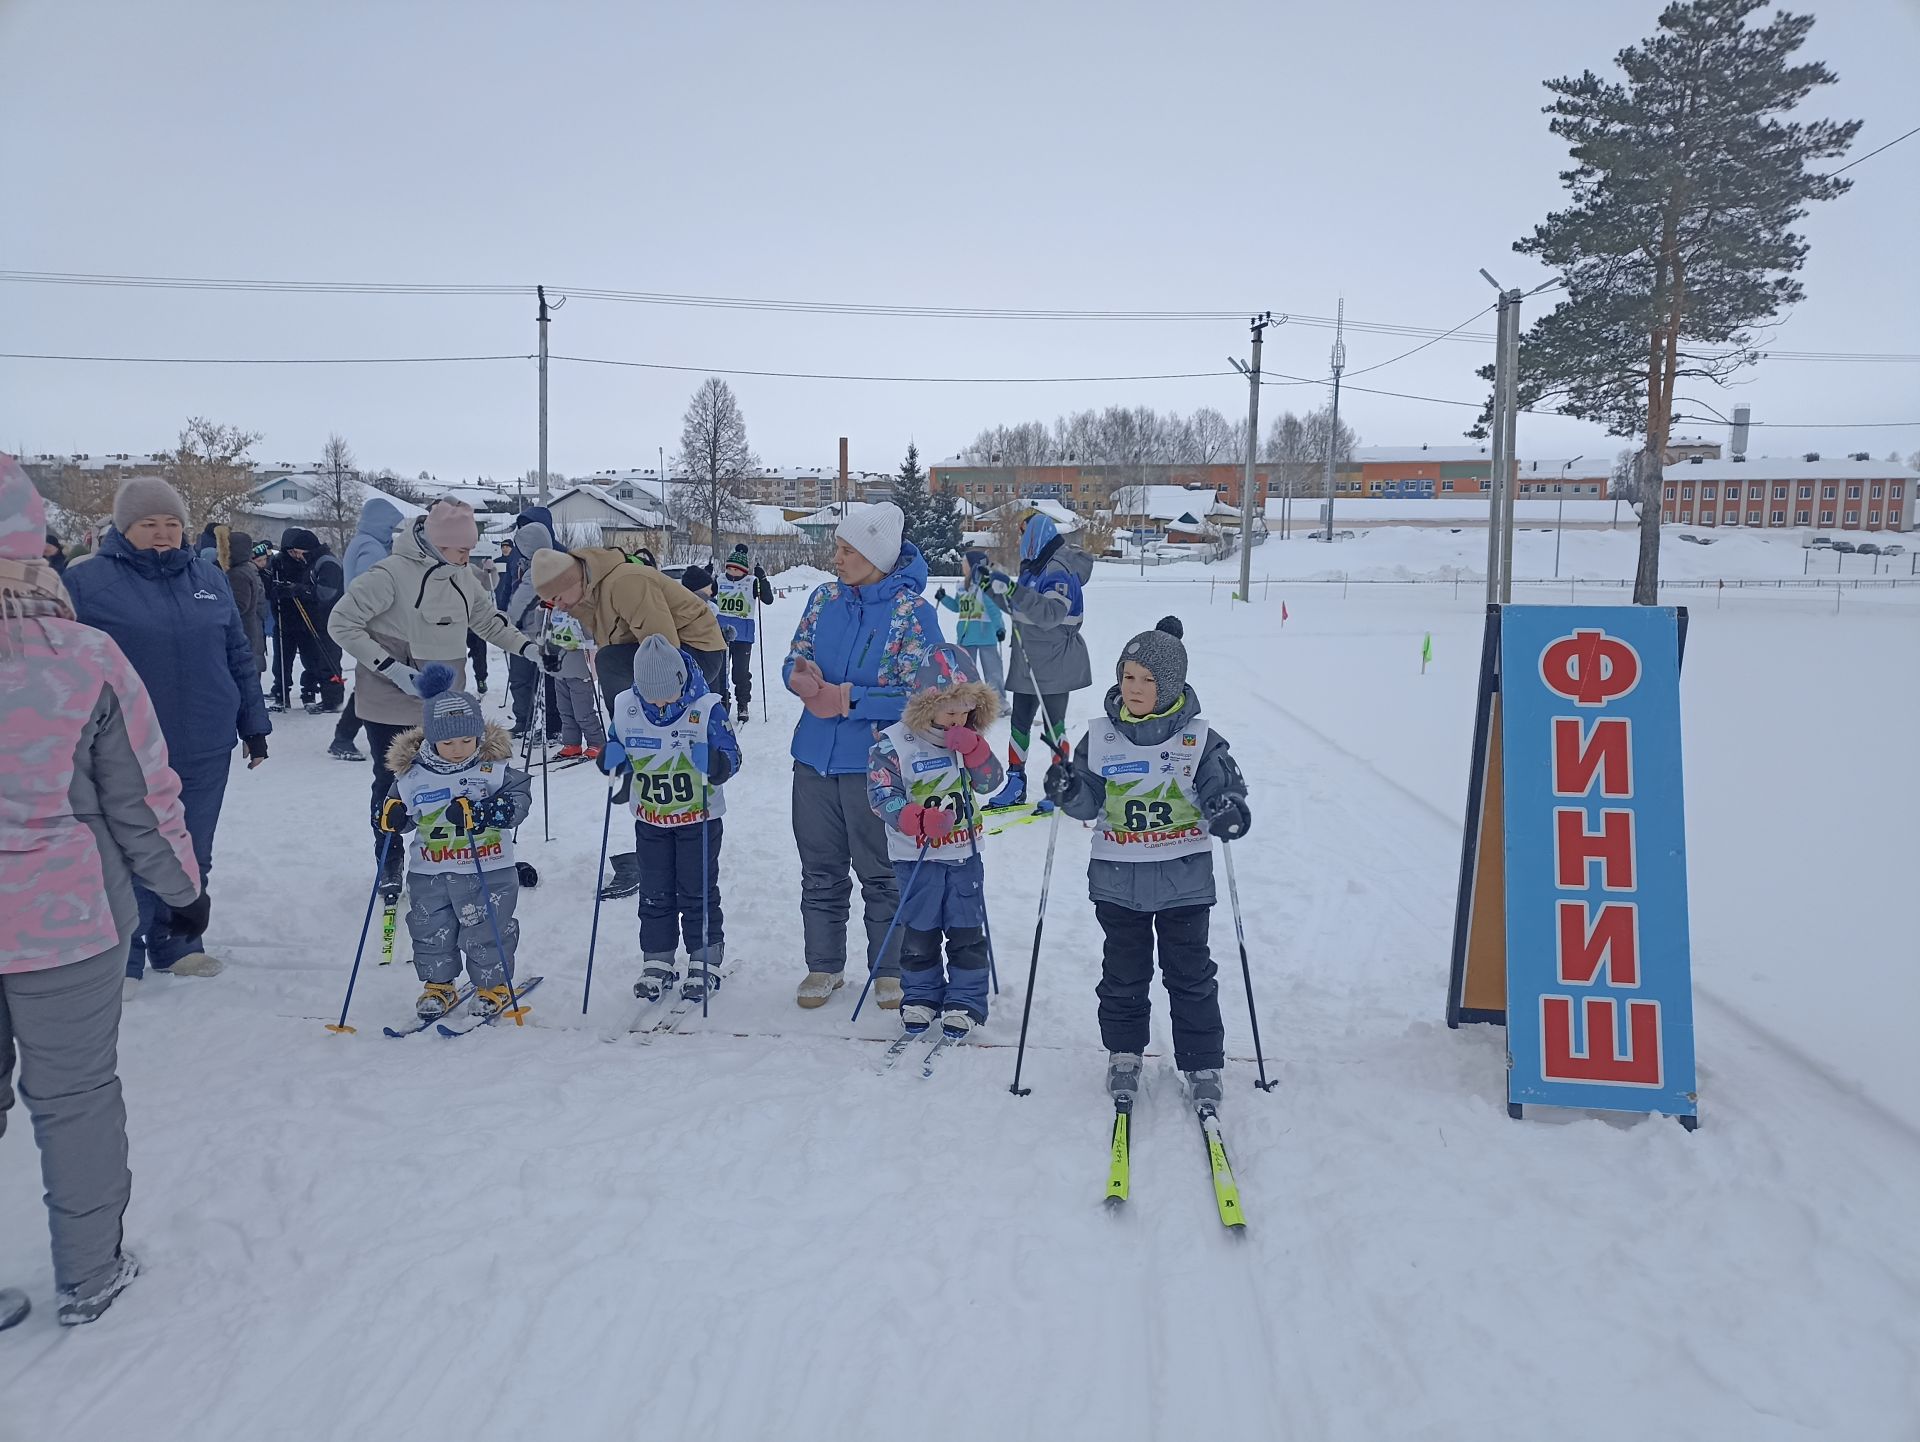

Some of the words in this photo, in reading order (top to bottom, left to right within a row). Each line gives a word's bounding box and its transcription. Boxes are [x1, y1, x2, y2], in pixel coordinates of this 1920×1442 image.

[720, 598, 744, 612] 209
[636, 773, 694, 805] 259
[636, 803, 710, 825] Kukmara
[1123, 799, 1174, 832] 63
[1538, 628, 1663, 1089] ФИНИШ
